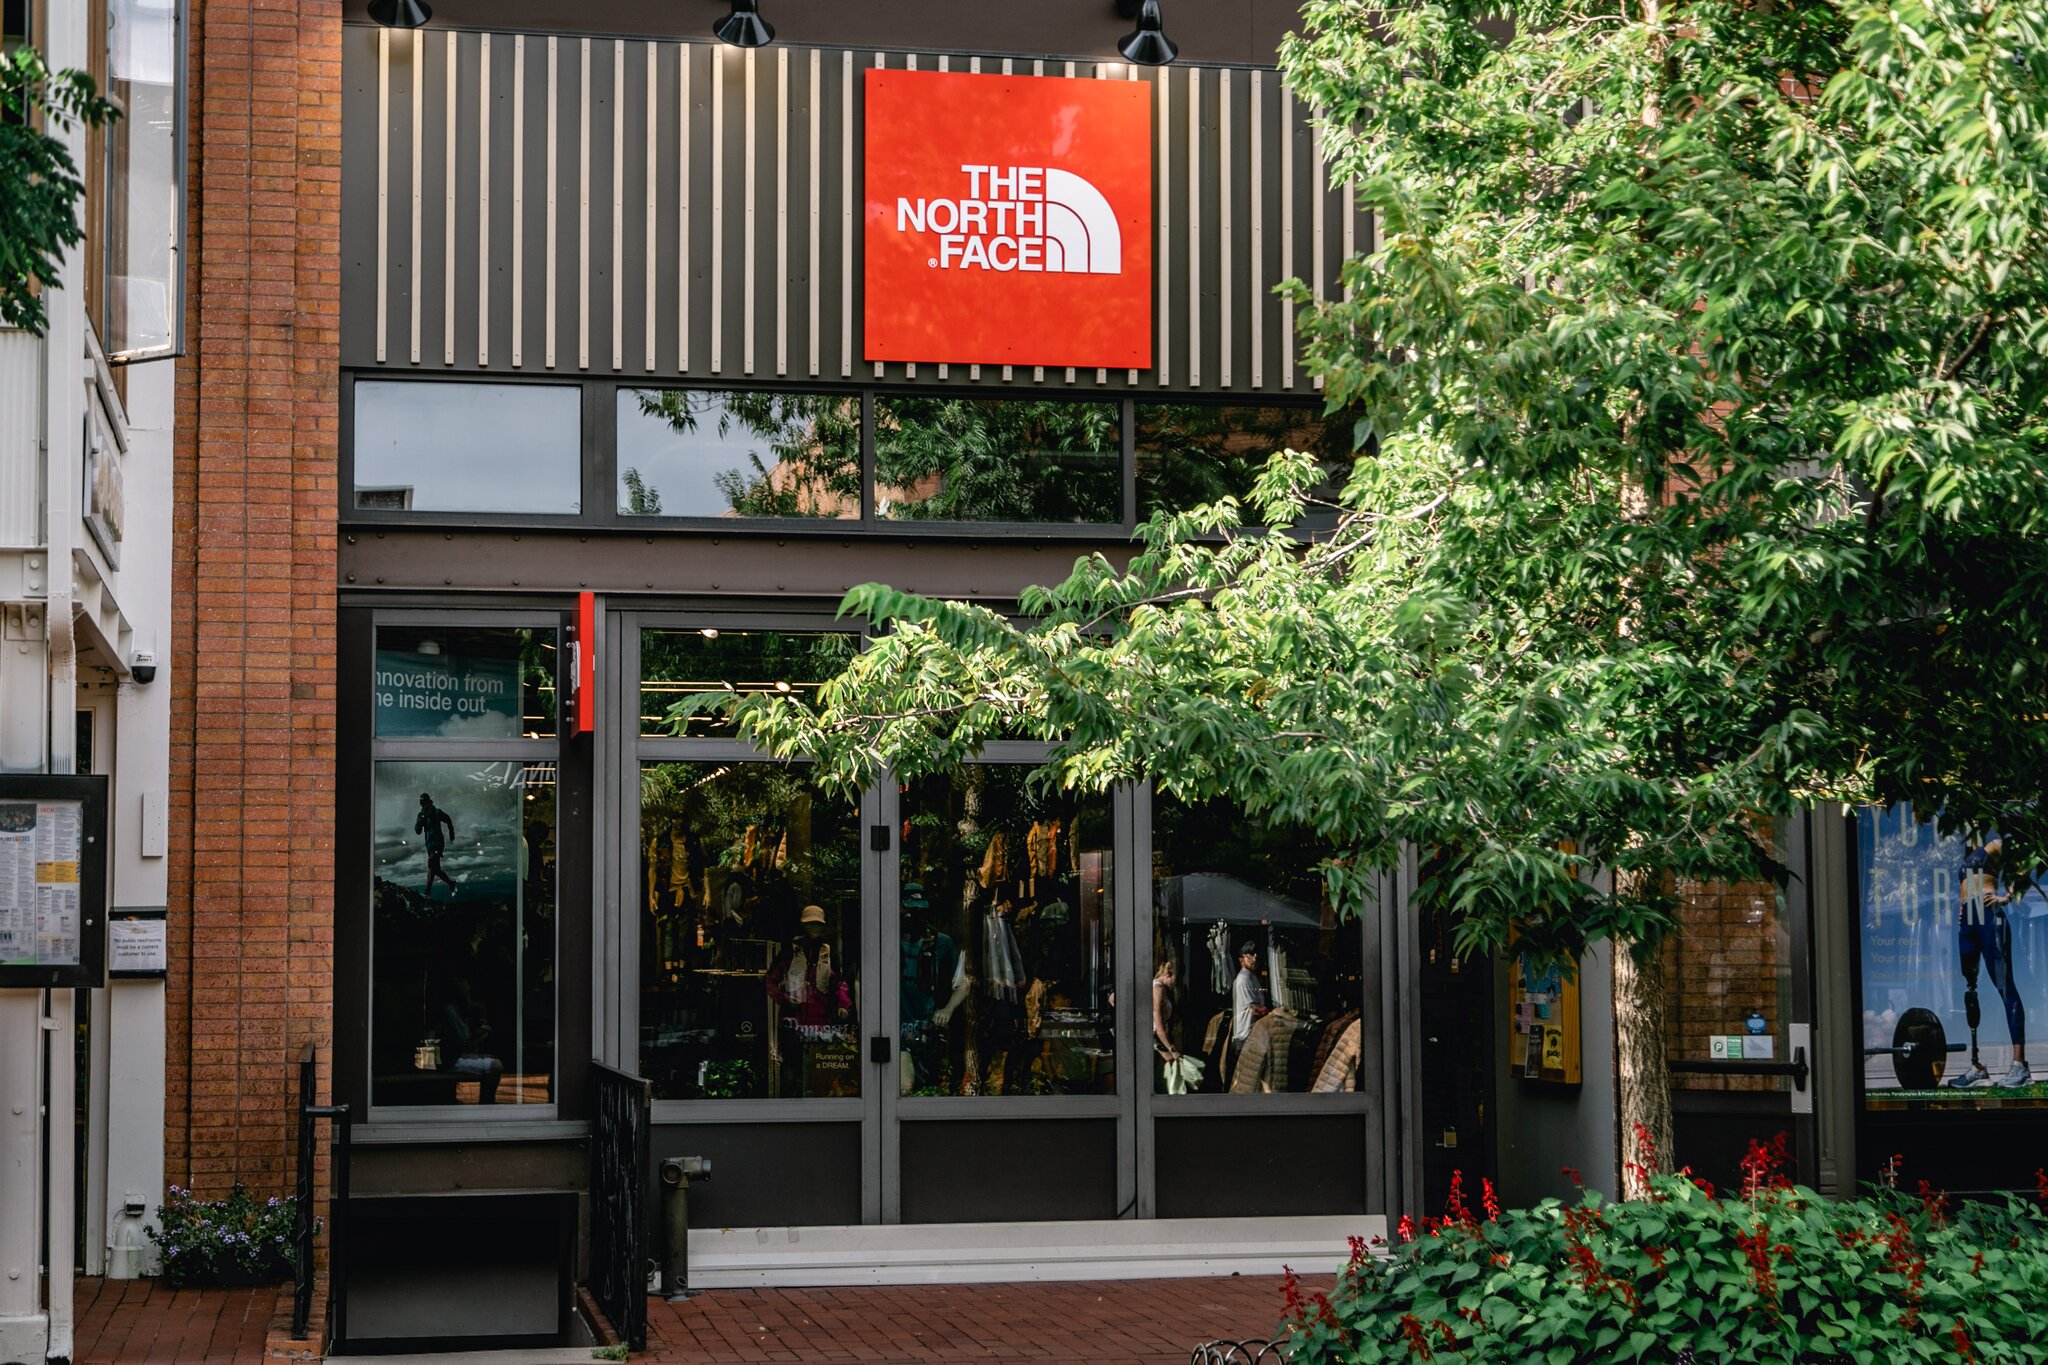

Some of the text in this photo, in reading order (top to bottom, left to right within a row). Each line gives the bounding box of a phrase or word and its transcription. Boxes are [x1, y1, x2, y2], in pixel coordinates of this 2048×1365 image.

[961, 164, 1043, 201] THE
[897, 197, 1043, 236] NORTH
[940, 234, 1043, 271] FACE
[463, 673, 503, 694] from
[400, 689, 452, 711] inside
[457, 695, 490, 713] out.
[1869, 867, 2003, 927] TURN.
[1871, 935, 1896, 946] Your
[815, 1052, 844, 1061] Running
